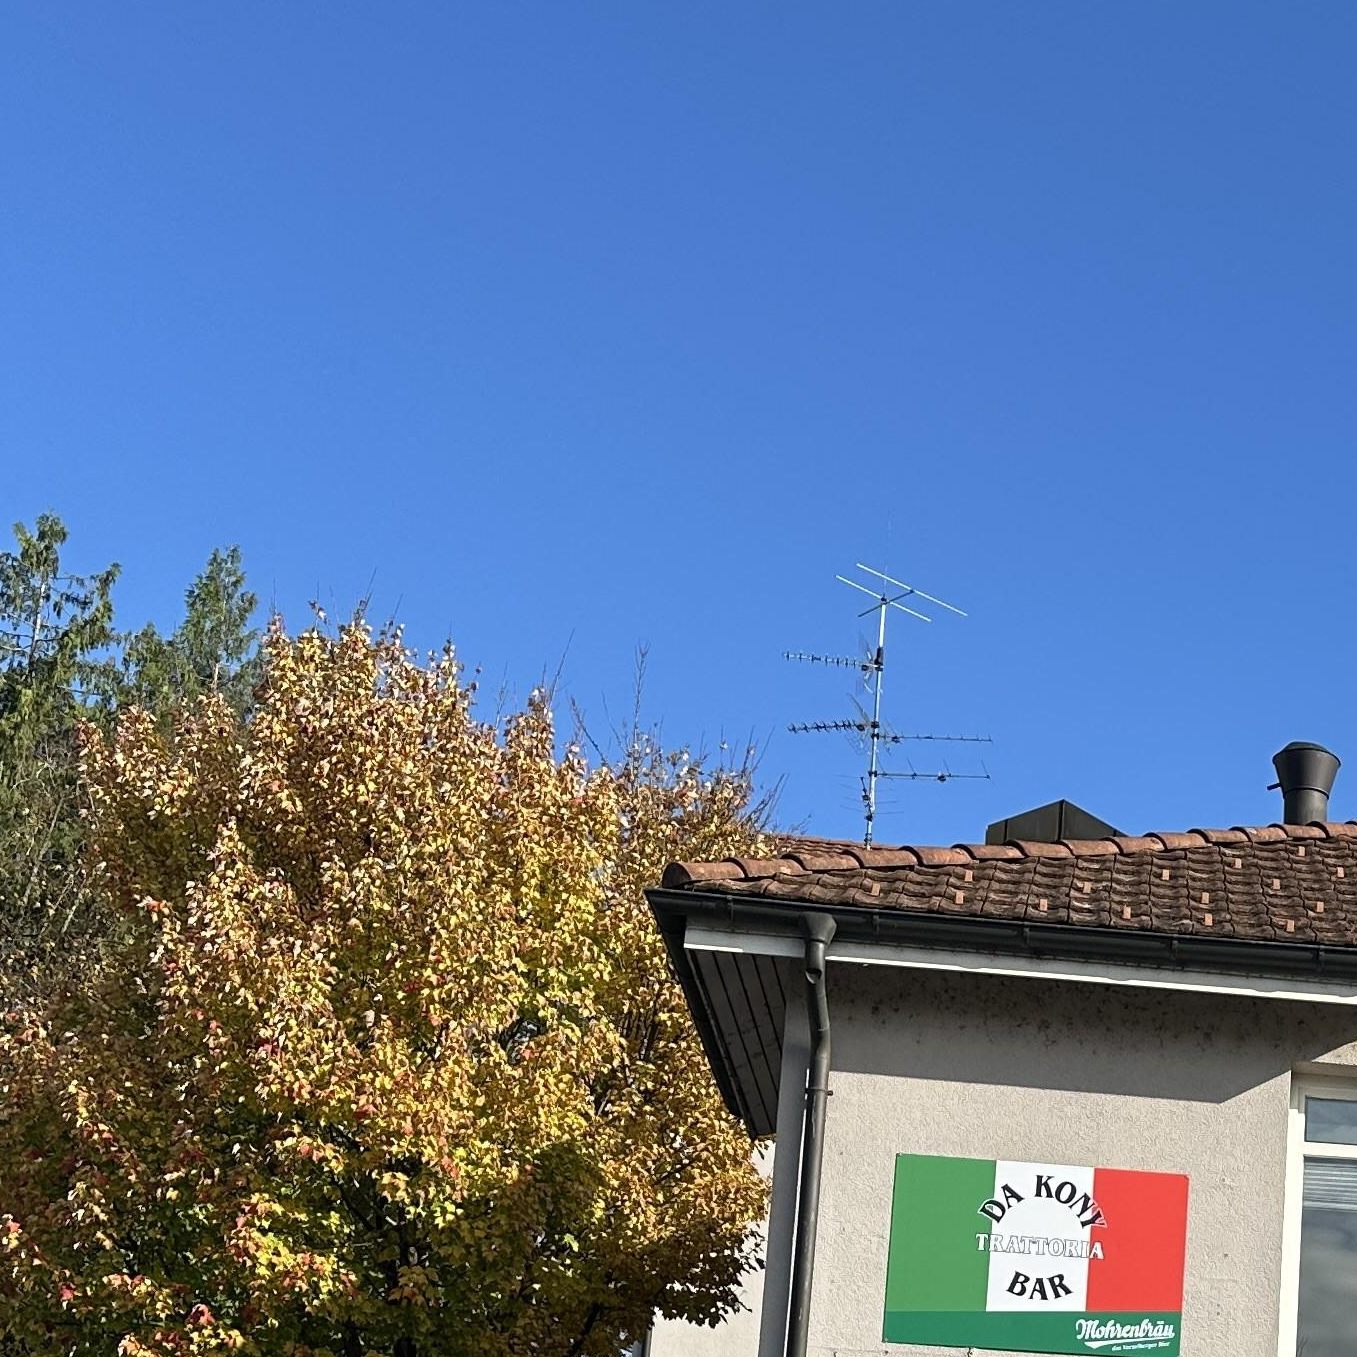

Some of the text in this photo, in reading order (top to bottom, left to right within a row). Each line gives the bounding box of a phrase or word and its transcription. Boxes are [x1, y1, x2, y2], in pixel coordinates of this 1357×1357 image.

[978, 1175, 1107, 1228] DA KONY
[976, 1233, 1104, 1260] TRATTORIA
[1006, 1271, 1073, 1300] BAR
[1076, 1318, 1175, 1340] Mohrenbräu
